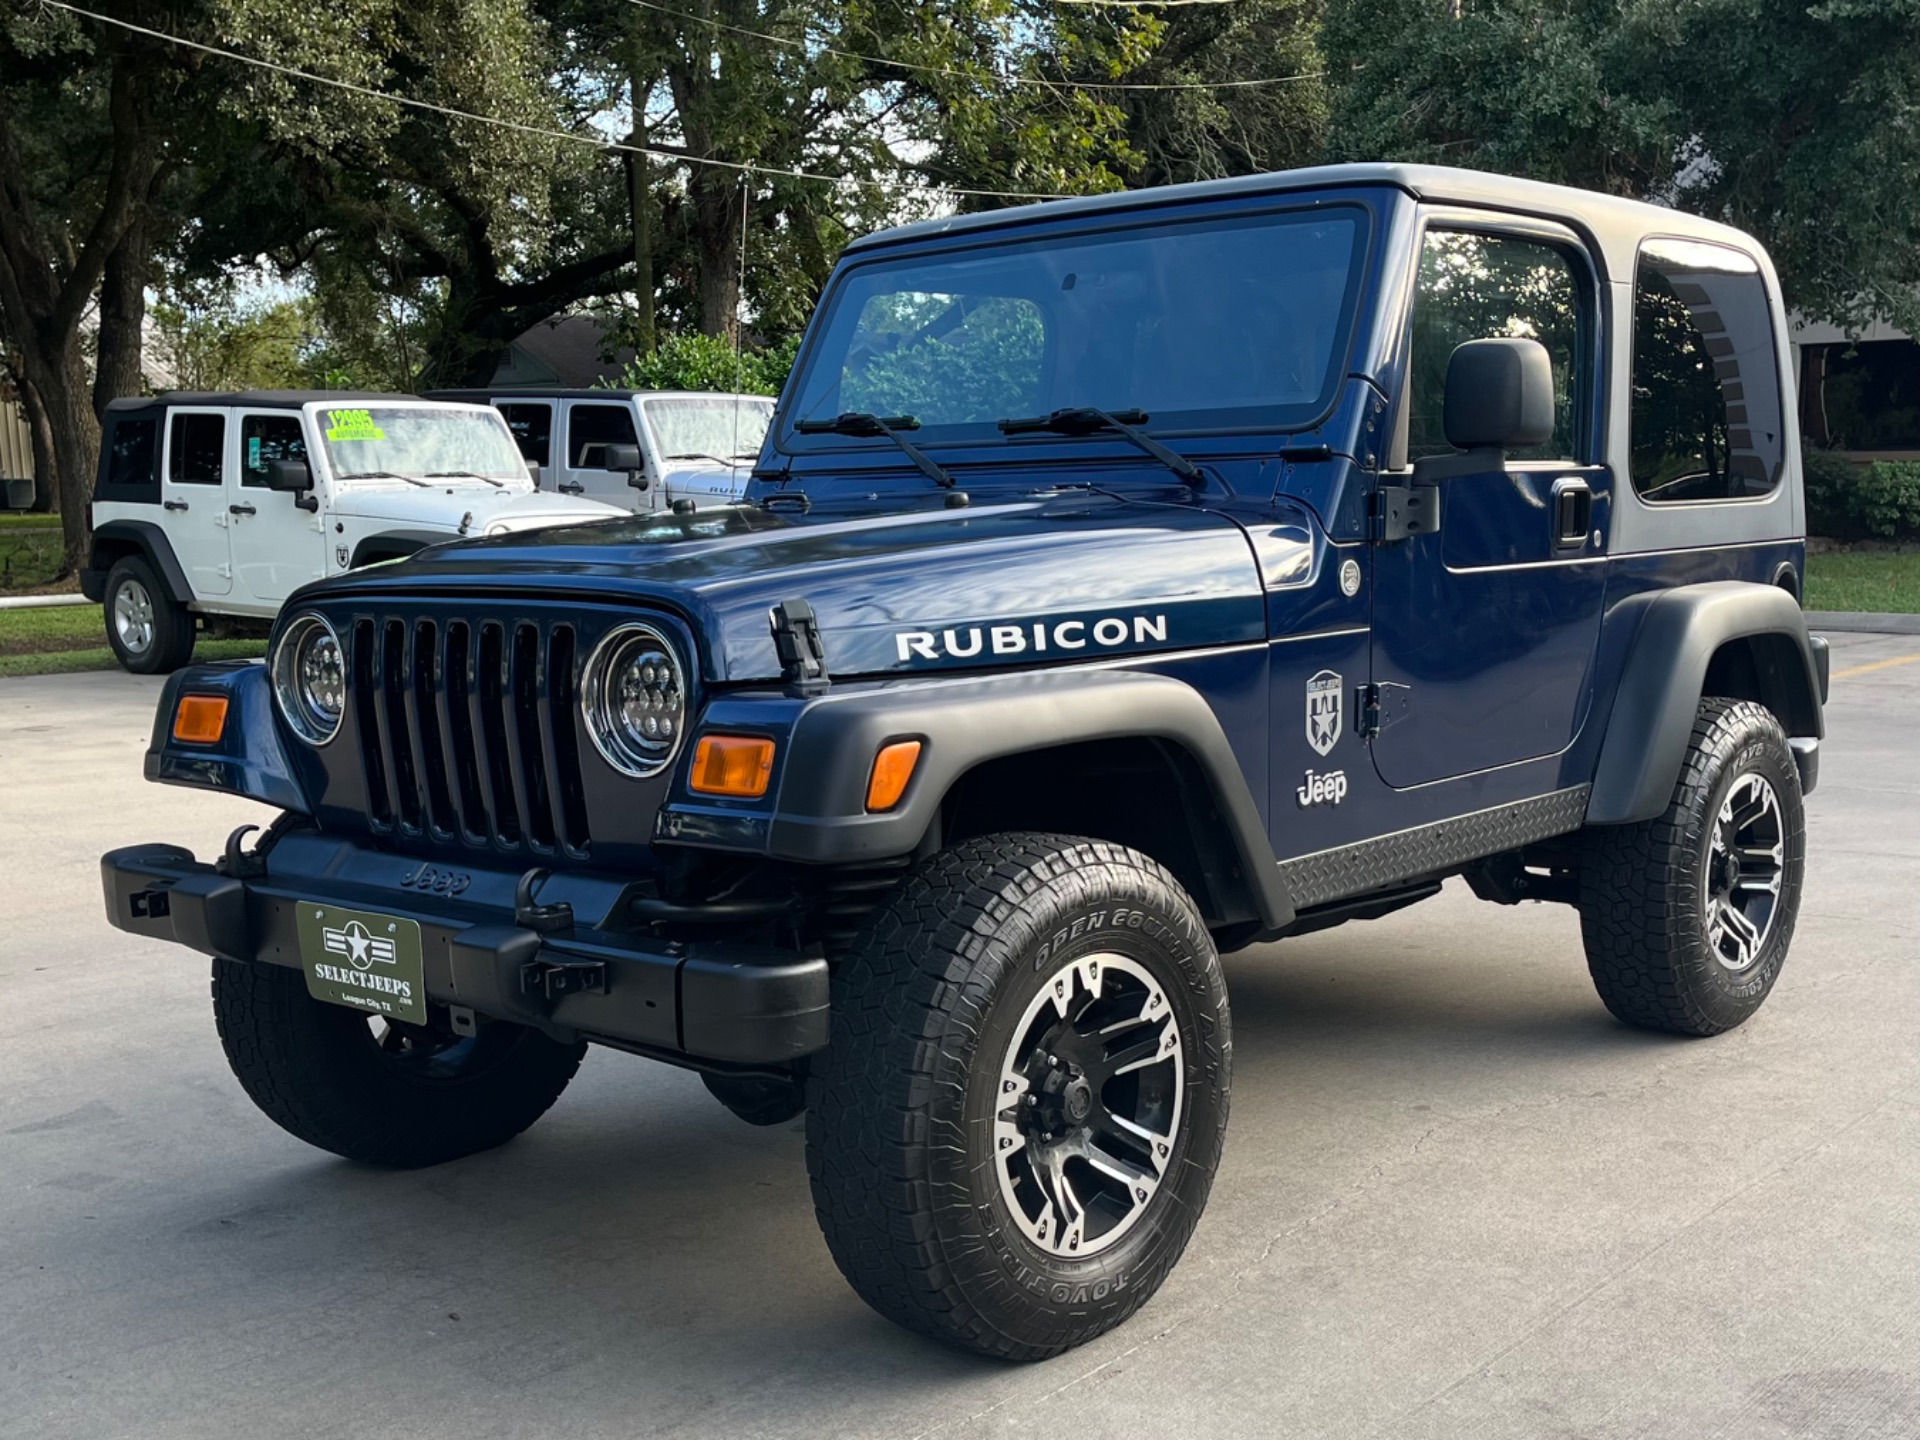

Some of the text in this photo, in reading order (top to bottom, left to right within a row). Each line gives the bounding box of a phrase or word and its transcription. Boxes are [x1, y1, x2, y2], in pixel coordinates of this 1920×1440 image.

[327, 410, 375, 431] 12995
[895, 615, 1167, 661] RUBICON
[1297, 769, 1347, 806] Jeep
[401, 862, 471, 898] Jeep
[1034, 911, 1107, 971] OPEN
[1111, 908, 1205, 995] COUNTRY
[315, 962, 411, 997] SELECTJEEPS
[381, 1001, 392, 1012] TX
[978, 1203, 1046, 1297] TIRES
[1051, 1268, 1130, 1303] TOYO
